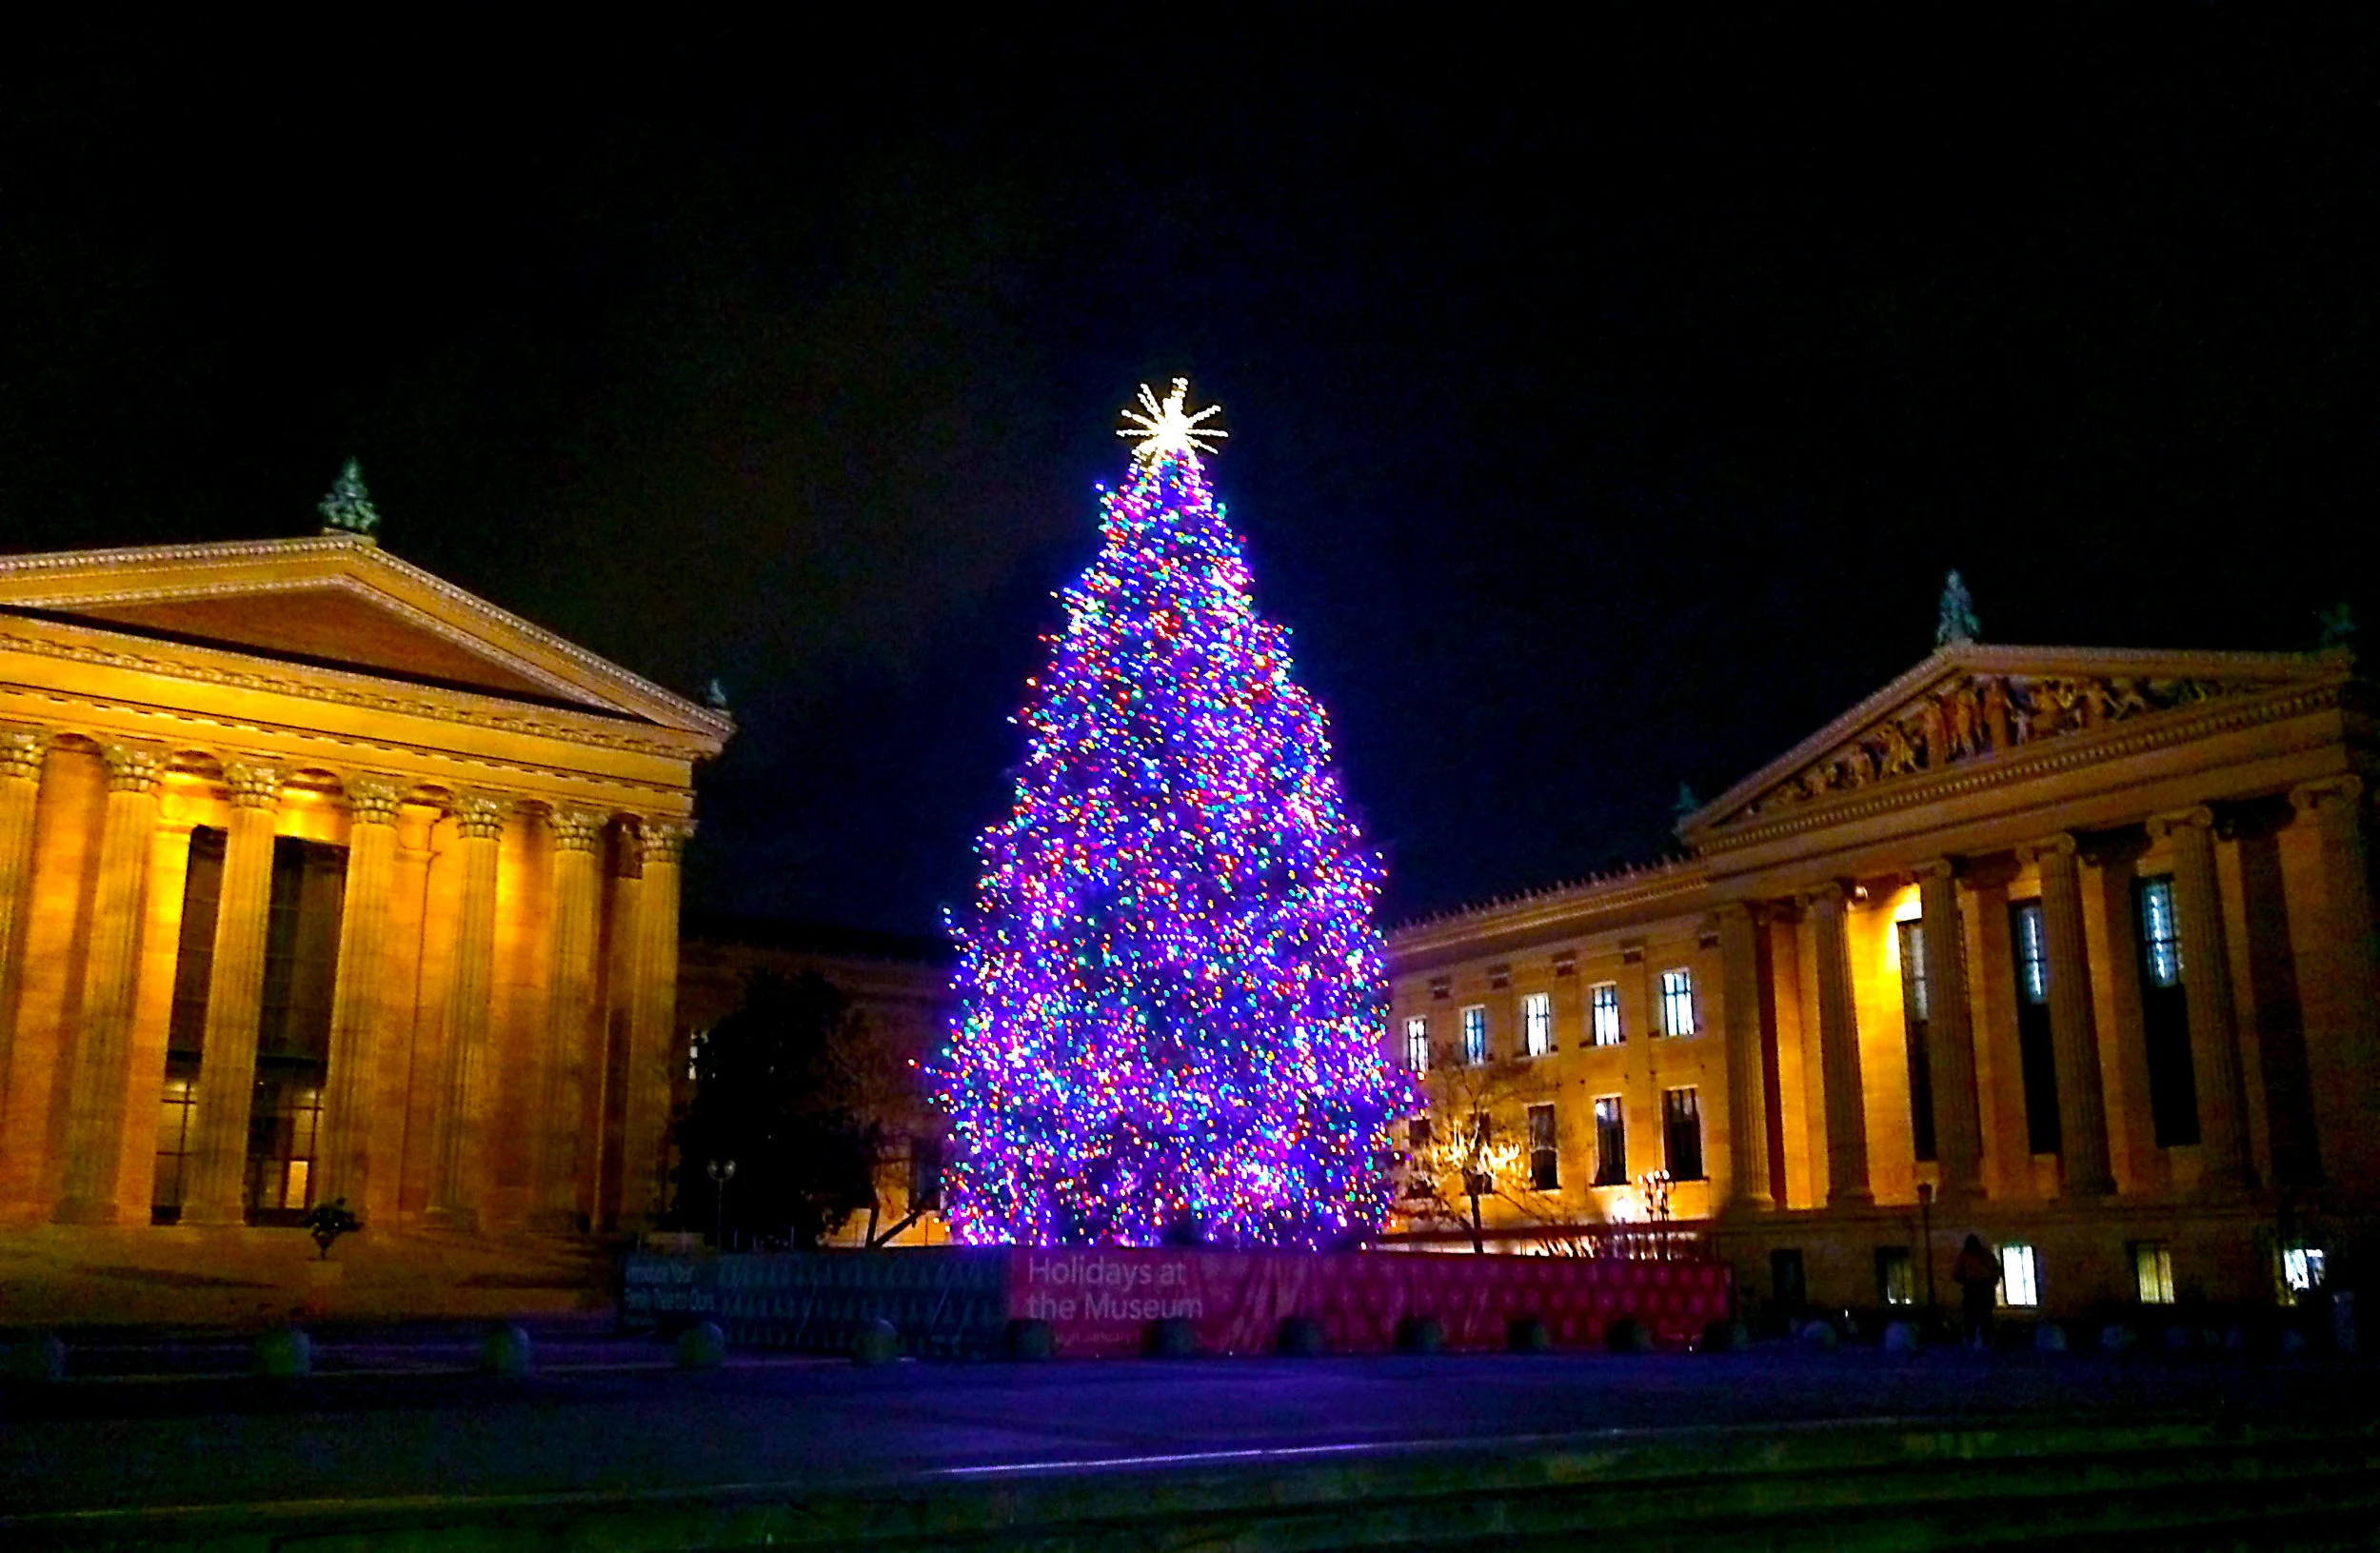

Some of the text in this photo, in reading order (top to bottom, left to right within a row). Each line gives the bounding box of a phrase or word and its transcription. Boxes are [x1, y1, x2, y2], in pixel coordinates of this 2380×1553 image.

[1028, 1255, 1186, 1292] Holidays at
[1028, 1292, 1204, 1322] the Museum
